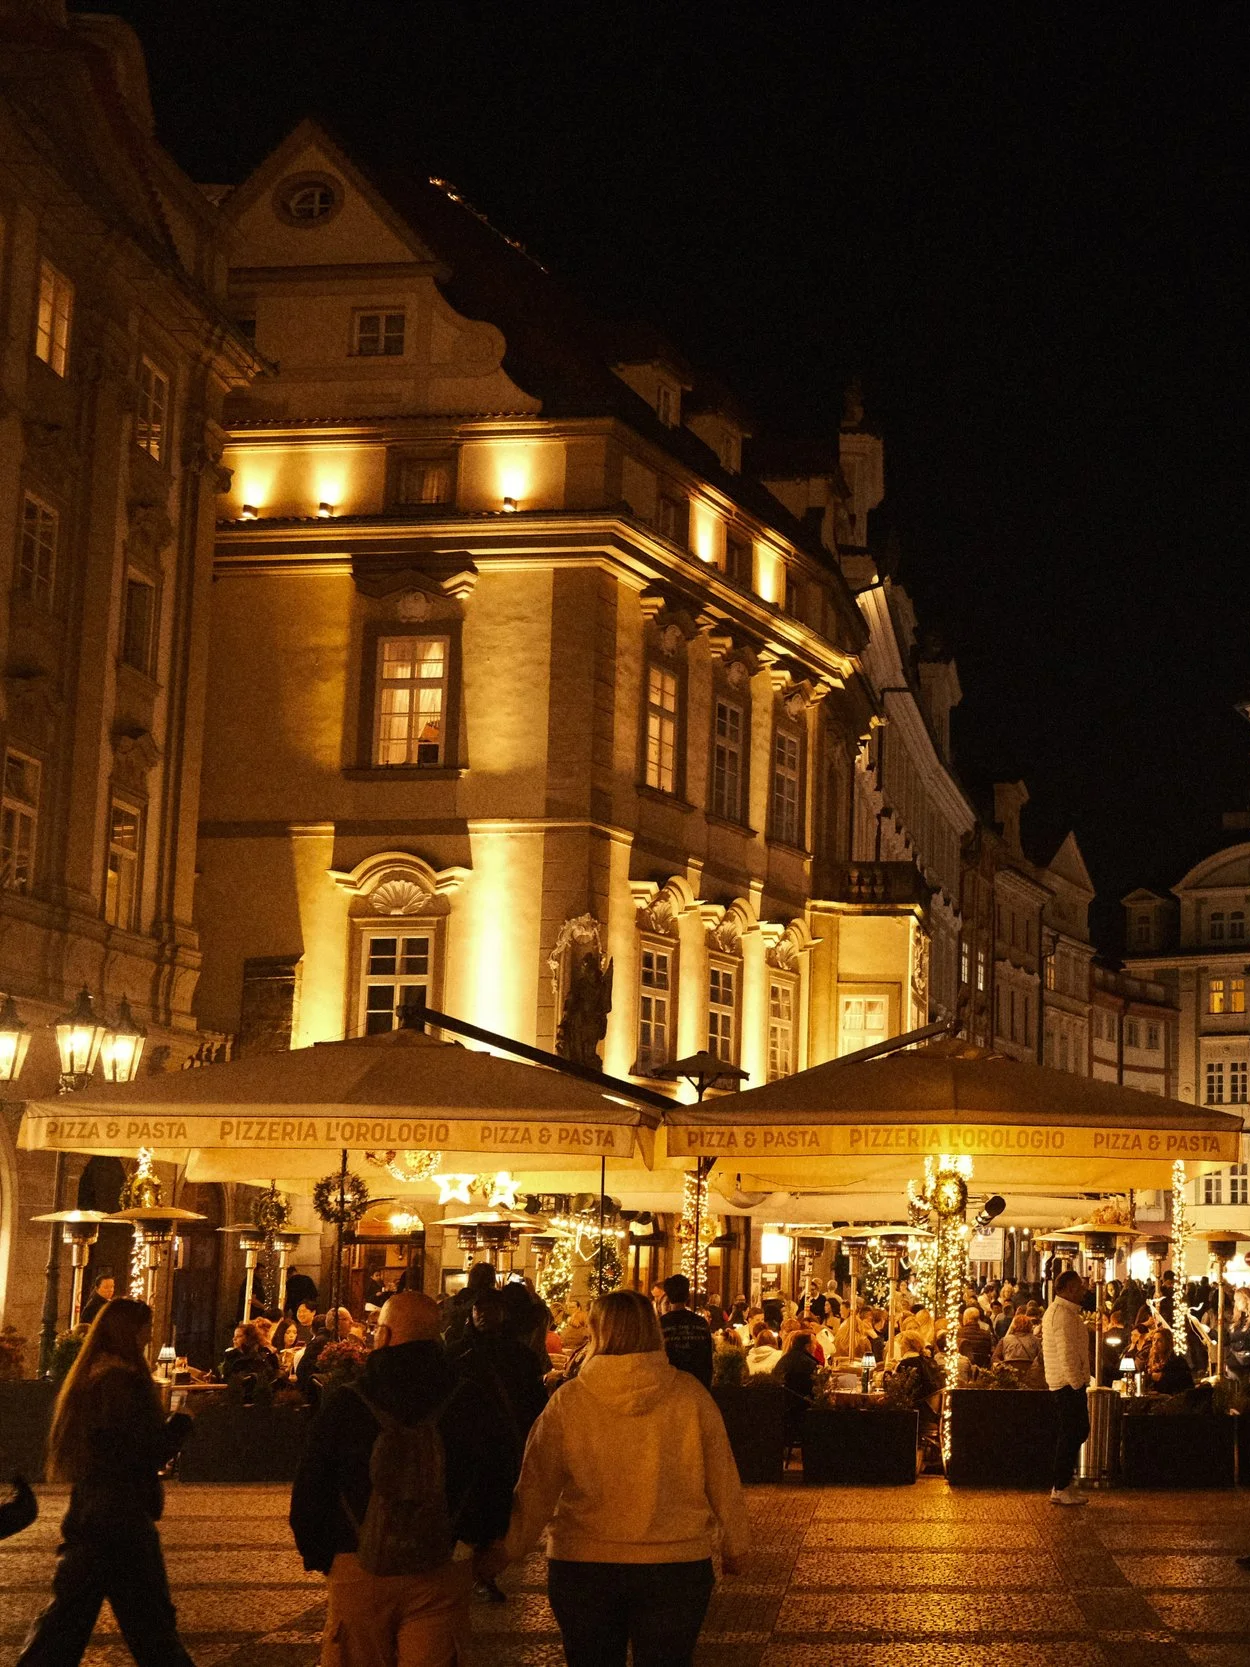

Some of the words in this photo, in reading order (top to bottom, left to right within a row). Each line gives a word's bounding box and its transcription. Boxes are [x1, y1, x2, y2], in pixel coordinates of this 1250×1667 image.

[45, 1121, 100, 1139] PIZZA
[106, 1122, 121, 1140] &
[126, 1122, 188, 1140] PASTA
[219, 1121, 318, 1141] PIZZERIA
[325, 1122, 450, 1143] L'OROLOGIO
[480, 1126, 533, 1144] PIZZA
[538, 1127, 553, 1145] &
[558, 1128, 615, 1147] PASTA
[687, 1131, 738, 1148] PIZZA
[744, 1131, 757, 1148] &
[763, 1131, 820, 1148] PASTA
[850, 1128, 943, 1148] PIZZERIA
[949, 1129, 1065, 1149] L'OROLOGIO
[1093, 1132, 1142, 1150] PIZZA
[1147, 1134, 1161, 1151] &
[1166, 1135, 1221, 1153] PASTA
